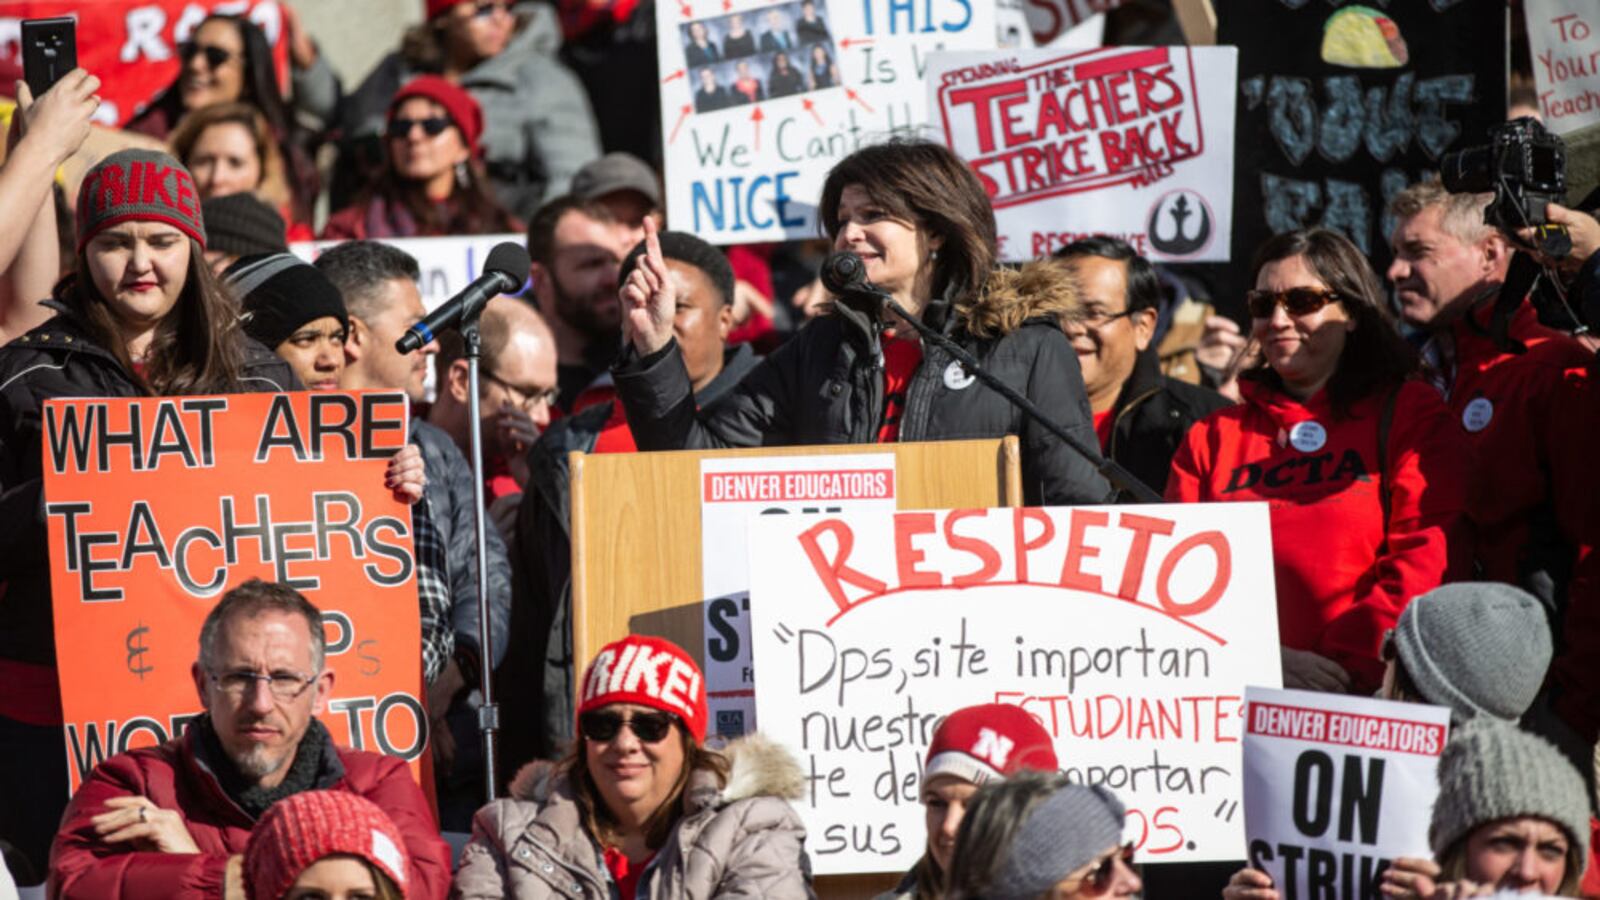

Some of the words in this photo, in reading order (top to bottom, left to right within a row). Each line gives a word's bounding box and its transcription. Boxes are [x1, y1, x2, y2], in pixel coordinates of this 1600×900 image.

[1551, 13, 1590, 42] To
[1538, 48, 1600, 83] Your
[950, 47, 1184, 154] TEACHERS
[692, 123, 751, 167] We
[968, 137, 1094, 194] STRIKE
[1100, 112, 1192, 174] BACK
[691, 172, 806, 232] NICE
[45, 397, 227, 473] WHAT
[254, 393, 405, 463] ARE
[711, 474, 780, 500] DENVER
[784, 472, 887, 498] EDUCATORS
[1221, 449, 1371, 494] DCTA
[47, 491, 415, 601] TEACHERS
[797, 506, 1232, 616] RESPETO
[1015, 627, 1209, 694] importan
[330, 691, 430, 762] TO
[971, 727, 1015, 769] N
[1254, 705, 1326, 741] DENVER
[1327, 714, 1440, 755] EDUCATORS
[1292, 749, 1386, 846] ON
[815, 822, 902, 856] sus
[1249, 838, 1392, 900] STRIK
